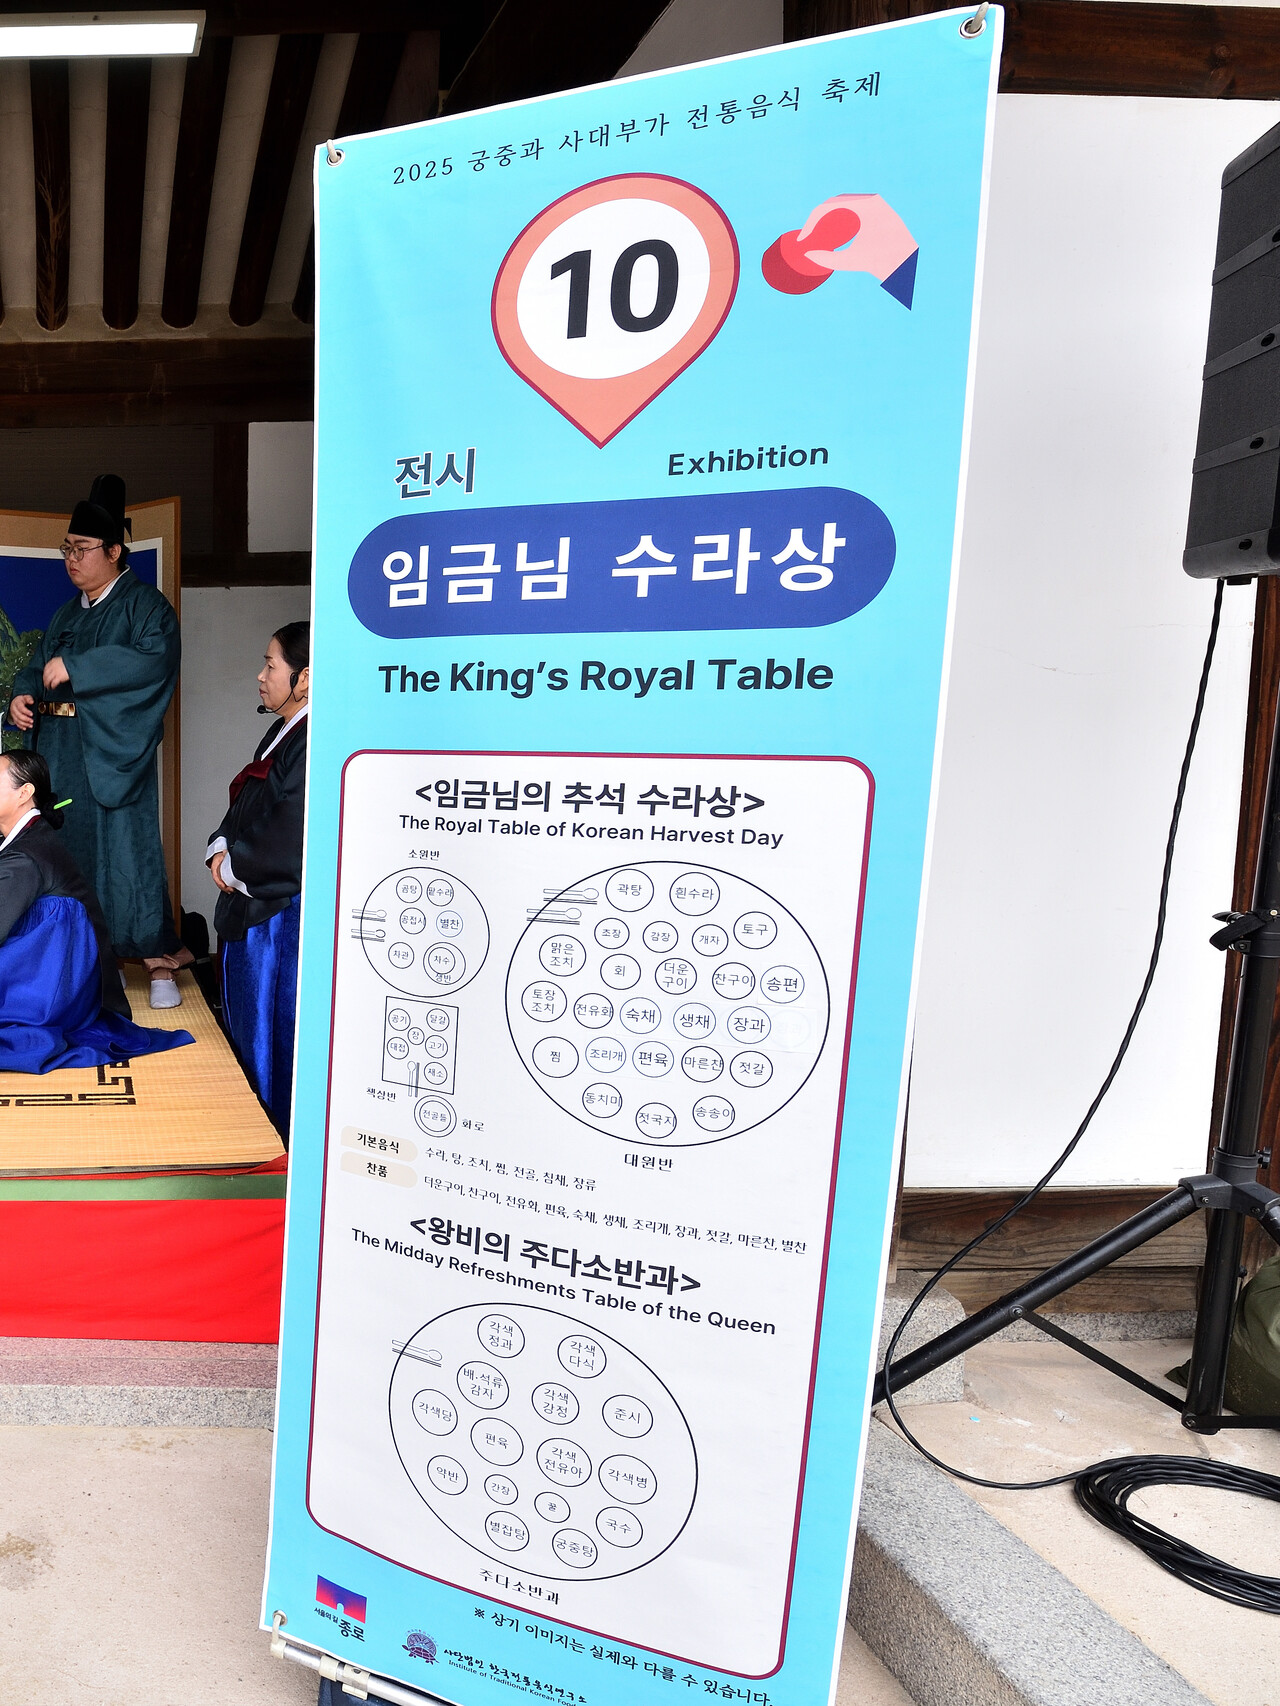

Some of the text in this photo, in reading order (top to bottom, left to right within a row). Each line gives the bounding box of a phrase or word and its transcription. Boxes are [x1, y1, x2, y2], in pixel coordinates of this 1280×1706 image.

[393, 71, 882, 184] 2025 궁중과 사대부가 전통음식 축제
[550, 239, 680, 339] 10
[668, 445, 829, 477] Exhibition
[394, 447, 477, 499] 전시
[381, 522, 847, 608] 임금님 수라상
[379, 663, 440, 693] The
[581, 659, 694, 698] Royal
[708, 657, 834, 691] Table
[416, 779, 766, 819] <임금님의 추석 수라상>
[399, 814, 784, 850] The Royal Table of Korean Harvest Day
[408, 849, 440, 861] 소원반
[617, 884, 643, 898] 곽탕
[675, 886, 715, 901] 흰수라
[440, 919, 460, 930] 별찬
[741, 923, 769, 936] 토구
[601, 928, 622, 939] 초장
[551, 942, 575, 955] 맑은
[549, 955, 574, 969] 조치
[663, 962, 690, 976] 더운
[614, 965, 626, 977] 회
[662, 977, 689, 990] 구이
[713, 973, 754, 988] 찬구이
[766, 976, 799, 992] 송편
[531, 989, 556, 1001] 토장
[531, 1002, 555, 1015] 조치
[625, 1009, 656, 1024] 숙채
[679, 1014, 711, 1030] 생채
[733, 1017, 766, 1034] 장과
[429, 1042, 445, 1052] 고기
[549, 1050, 562, 1063] 찜
[589, 1049, 624, 1063] 조리개
[638, 1052, 669, 1068] 편육
[684, 1056, 723, 1072] 마른찬
[739, 1061, 766, 1076] 젓갈
[585, 1093, 621, 1108] 동치미
[695, 1106, 734, 1121] 송송이
[357, 1132, 400, 1154] 기본음식
[366, 1162, 388, 1178] 찬품
[624, 1153, 674, 1173] 대원반
[573, 1176, 597, 1192] 장류
[781, 1239, 808, 1255] 별찬
[409, 1216, 701, 1296] <왕비의 주다소반과>
[351, 1227, 777, 1336] The Midday Refreshments Table of the Queen
[489, 1321, 514, 1337] 각색
[488, 1335, 514, 1351] 정과
[570, 1341, 596, 1357] 각색
[569, 1355, 595, 1371] 다식
[470, 1383, 495, 1400] 감자
[543, 1388, 569, 1404] 각색
[418, 1402, 453, 1422] 각색당
[542, 1401, 568, 1418] 강정
[614, 1408, 641, 1424] 준시
[485, 1432, 509, 1450] 편육
[551, 1446, 577, 1463] 각색
[436, 1466, 459, 1483] 약반
[544, 1459, 583, 1479] 전유아
[608, 1468, 649, 1489] 각색병
[490, 1519, 527, 1541] 별잡탕
[605, 1518, 632, 1535] 국수
[555, 1537, 595, 1559] 궁중탕
[479, 1567, 561, 1606] 주다소반과
[338, 1619, 365, 1642] 종로
[491, 1612, 520, 1633] 상기
[525, 1624, 586, 1654] 이미지는
[589, 1644, 639, 1671] 실제와
[643, 1661, 677, 1683] 다를
[680, 1673, 698, 1688] 수
[448, 1659, 477, 1675] Institute
[490, 1674, 527, 1692] Traditional
[529, 1688, 555, 1702] Korean
